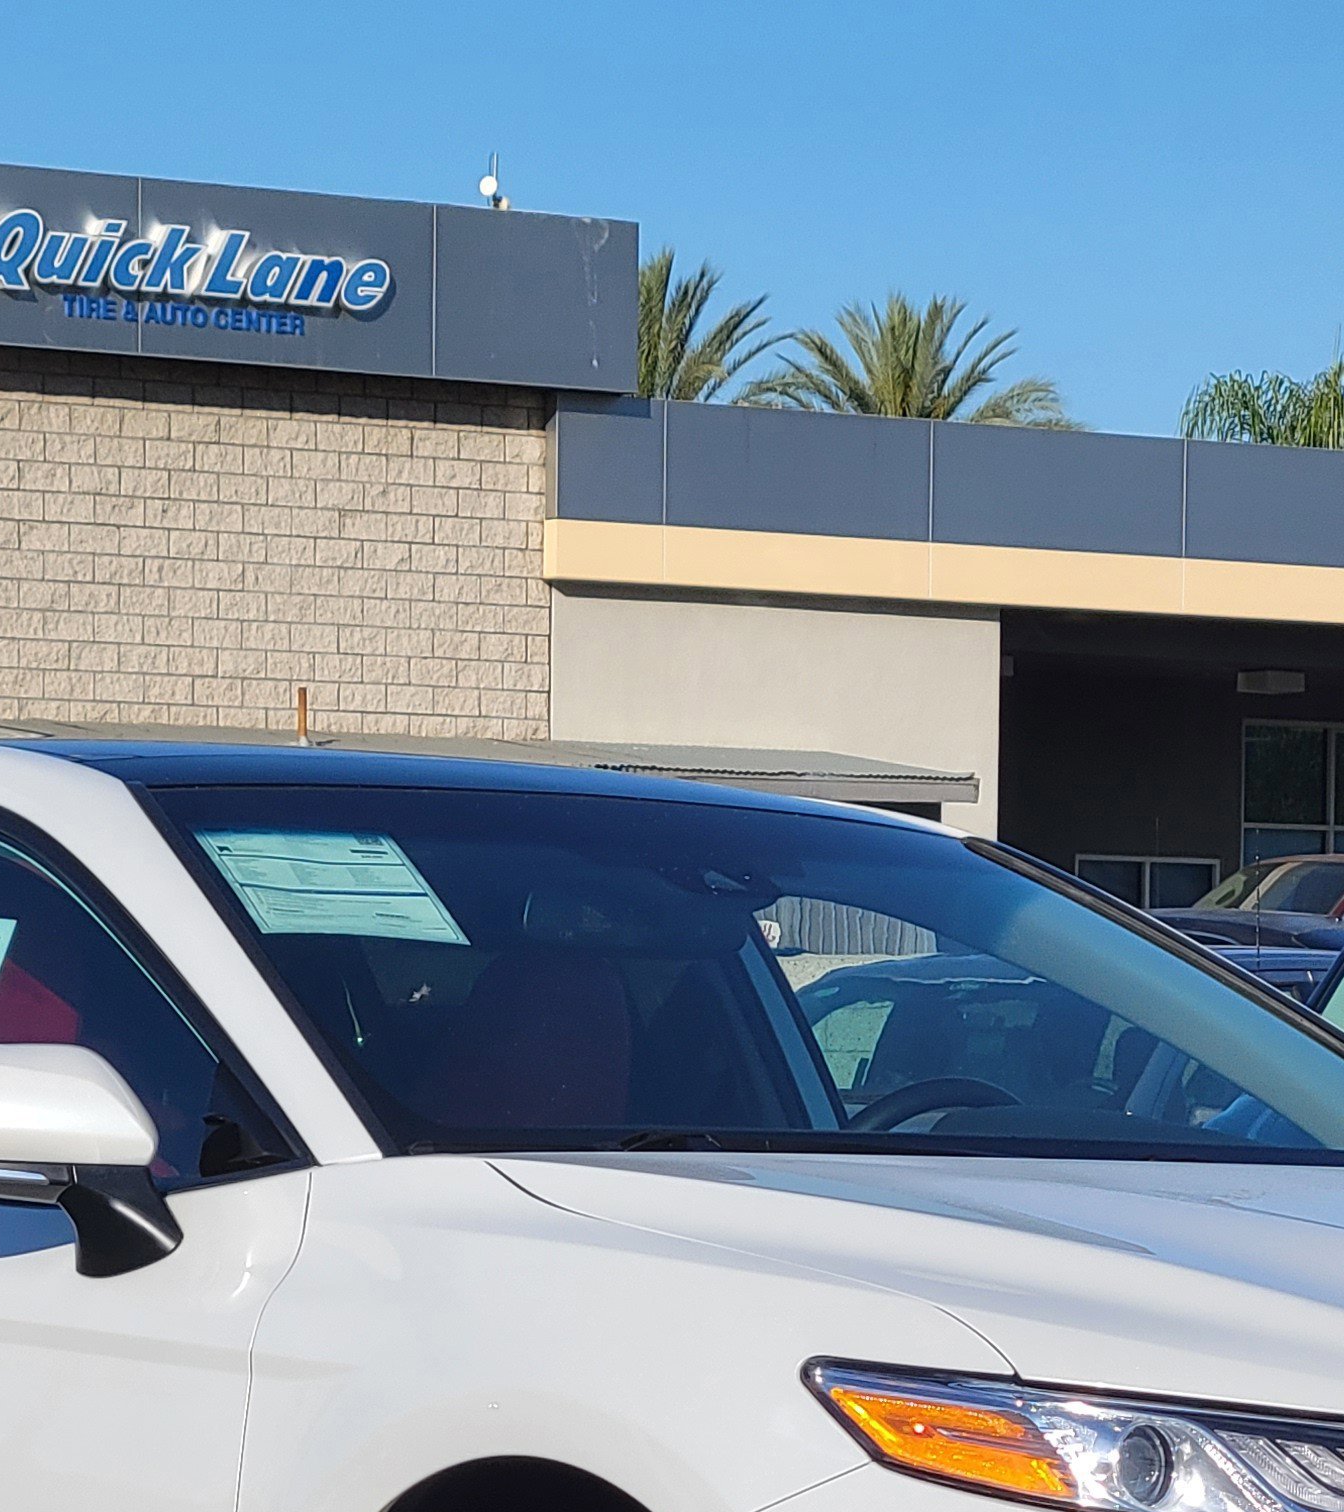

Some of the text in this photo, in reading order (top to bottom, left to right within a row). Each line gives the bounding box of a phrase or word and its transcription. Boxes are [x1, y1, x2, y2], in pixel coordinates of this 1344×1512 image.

[203, 229, 392, 312] Lane
[63, 294, 306, 336] TIRE & AUTO CENTER
